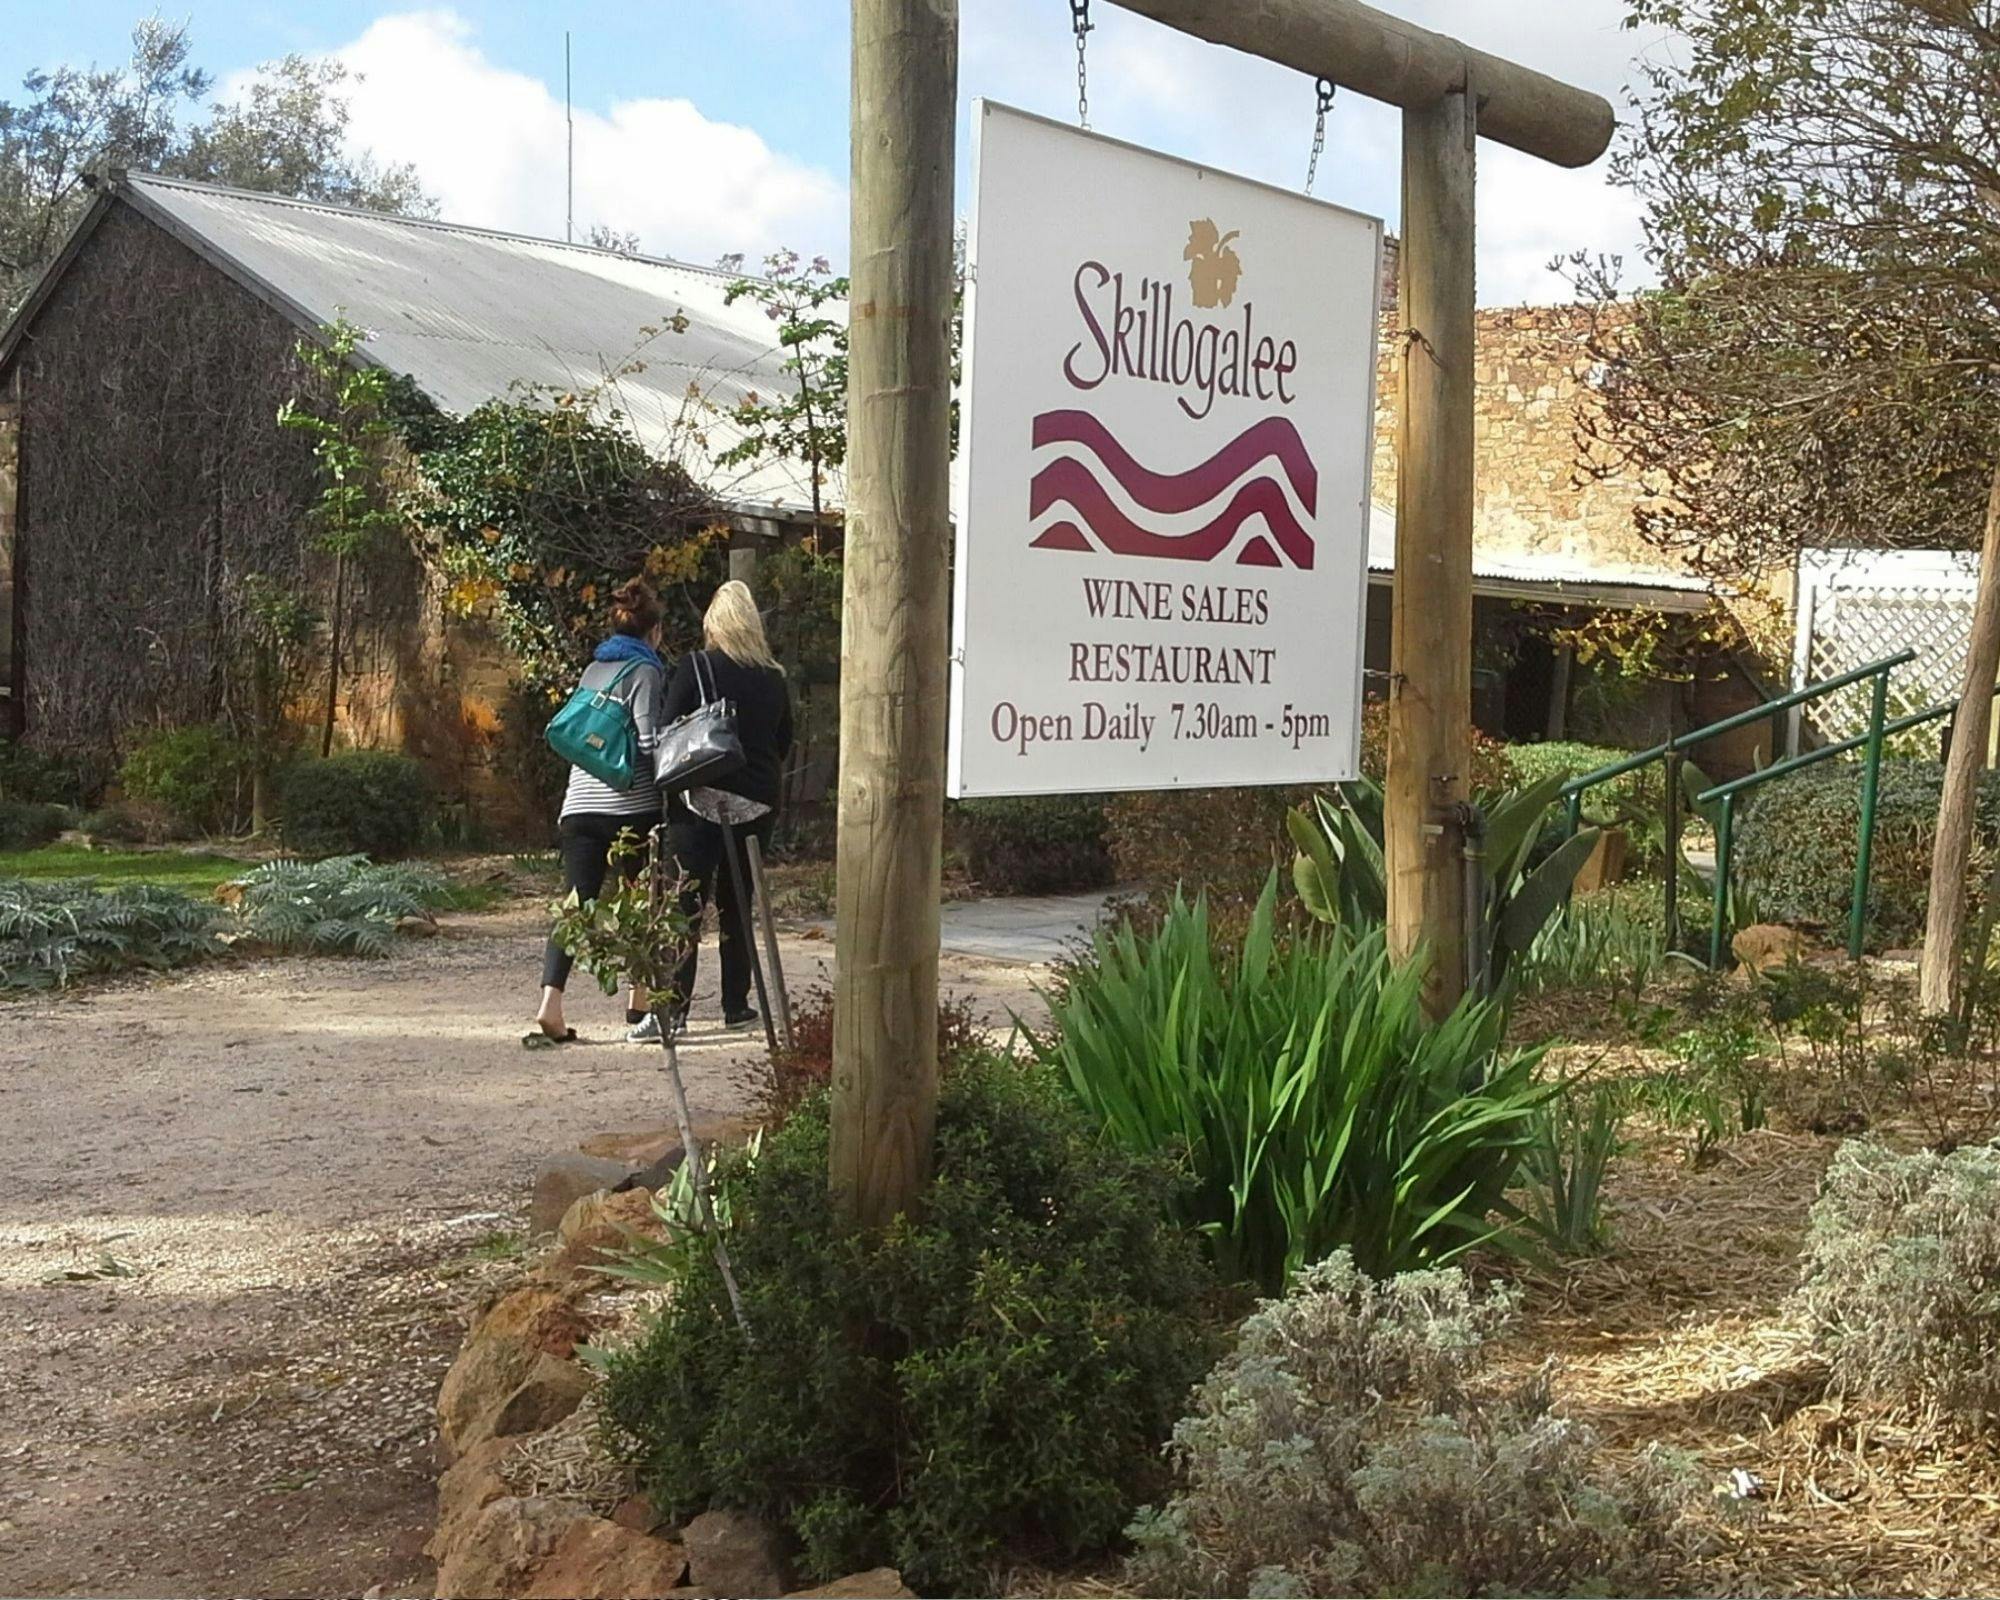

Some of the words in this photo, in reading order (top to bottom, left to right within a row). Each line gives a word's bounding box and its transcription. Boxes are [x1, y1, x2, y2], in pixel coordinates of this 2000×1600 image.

[1063, 261, 1297, 419] Skillogalee
[1082, 577, 1173, 621] WINE
[1181, 583, 1269, 626] SALES
[1068, 642, 1277, 685] RESTAURANT
[991, 701, 1073, 756] Open
[1081, 702, 1156, 753] Daily
[1170, 702, 1258, 740] 7.30am
[1280, 703, 1330, 751] 5pm
